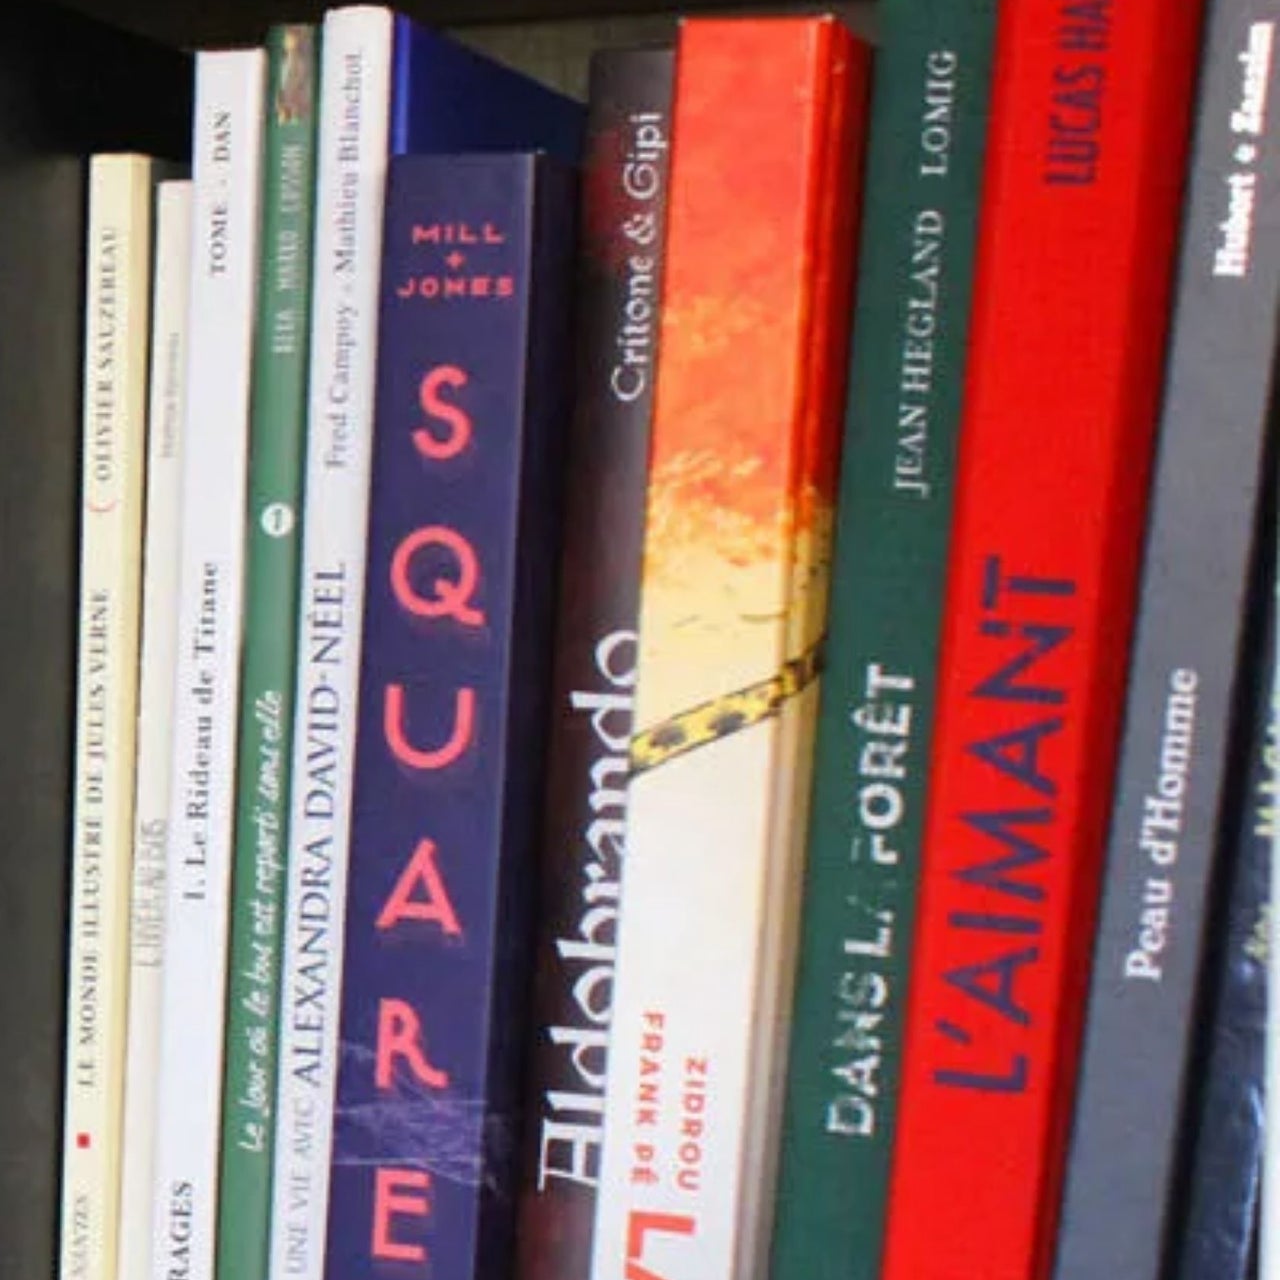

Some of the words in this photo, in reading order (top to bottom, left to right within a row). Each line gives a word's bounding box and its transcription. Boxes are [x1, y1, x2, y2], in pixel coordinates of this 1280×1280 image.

[211, 109, 233, 163] DAN
[336, 49, 363, 162] Blanchot
[919, 50, 958, 178] LOMIG
[1043, 64, 1104, 188] LUCAS
[622, 112, 667, 200] Gipi
[208, 200, 229, 276] TOME
[332, 172, 360, 274] Mathieu
[411, 224, 506, 246] MILL
[620, 212, 657, 246] &
[1210, 172, 1257, 278] Hubert
[97, 225, 119, 372] SAUZEREAU
[396, 274, 515, 300] JONES
[609, 255, 654, 402] Critone
[899, 209, 945, 393] HEGLAND
[326, 304, 360, 404] Campoy
[95, 379, 117, 481] OLIVIER
[323, 412, 348, 470] Fred
[892, 403, 931, 499] JEAN
[87, 588, 110, 673] VERNE
[191, 561, 218, 660] Titane
[84, 682, 107, 763] JULES
[189, 670, 214, 706] de
[254, 690, 283, 742] elle
[299, 561, 346, 821] DAVID-NÉEL
[83, 769, 103, 804] DE
[185, 715, 213, 820] Rideau
[258, 748, 282, 803] sans
[1138, 667, 1200, 866] d'Homme
[184, 830, 208, 867] Le
[251, 807, 285, 893] reparti
[371, 364, 488, 1262] SQUARE
[933, 554, 1076, 1097] L'AIMANT
[243, 943, 272, 984] bus
[248, 901, 273, 936] est
[290, 835, 334, 1088] ALEXANDRA
[1124, 880, 1174, 983] Peau
[78, 953, 98, 1046] MONDE
[239, 990, 270, 1017] le
[76, 1058, 95, 1087] LE
[632, 1011, 666, 1127] FRANK
[825, 972, 887, 1139] DANS
[235, 1122, 265, 1152] Le
[630, 1142, 659, 1186] PÉ
[674, 1057, 709, 1193] ZIDROU
[287, 1168, 312, 1212] VIE
[282, 1221, 309, 1275] UNE
